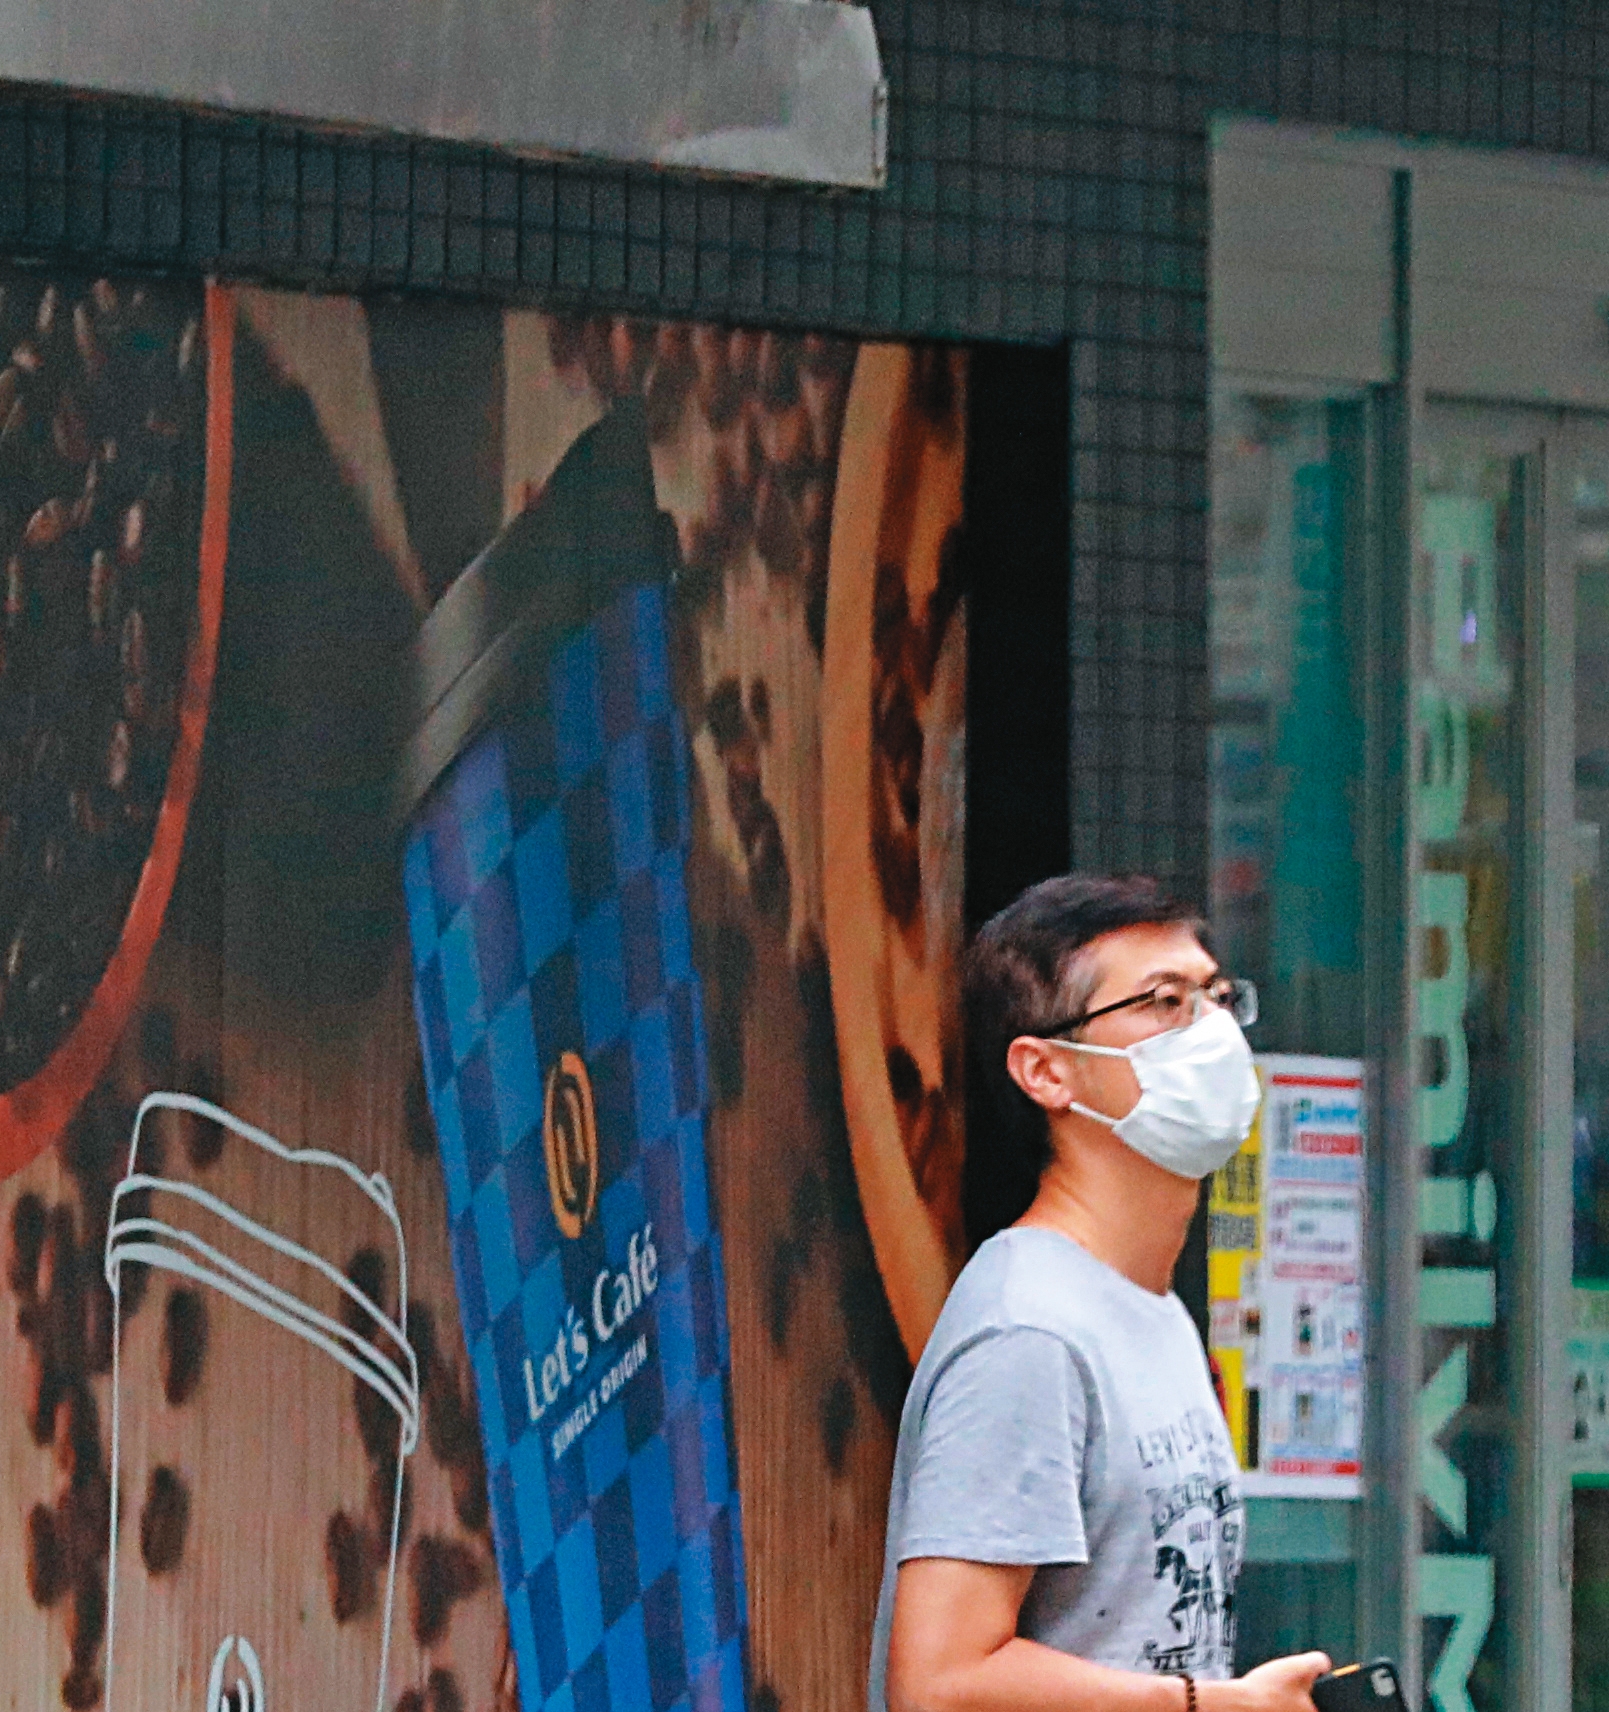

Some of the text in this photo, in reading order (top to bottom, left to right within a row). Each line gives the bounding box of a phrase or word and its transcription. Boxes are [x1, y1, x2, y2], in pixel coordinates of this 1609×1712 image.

[523, 1222, 659, 1421] Let's Café
[552, 1333, 648, 1461] SINGLE ORIGIN
